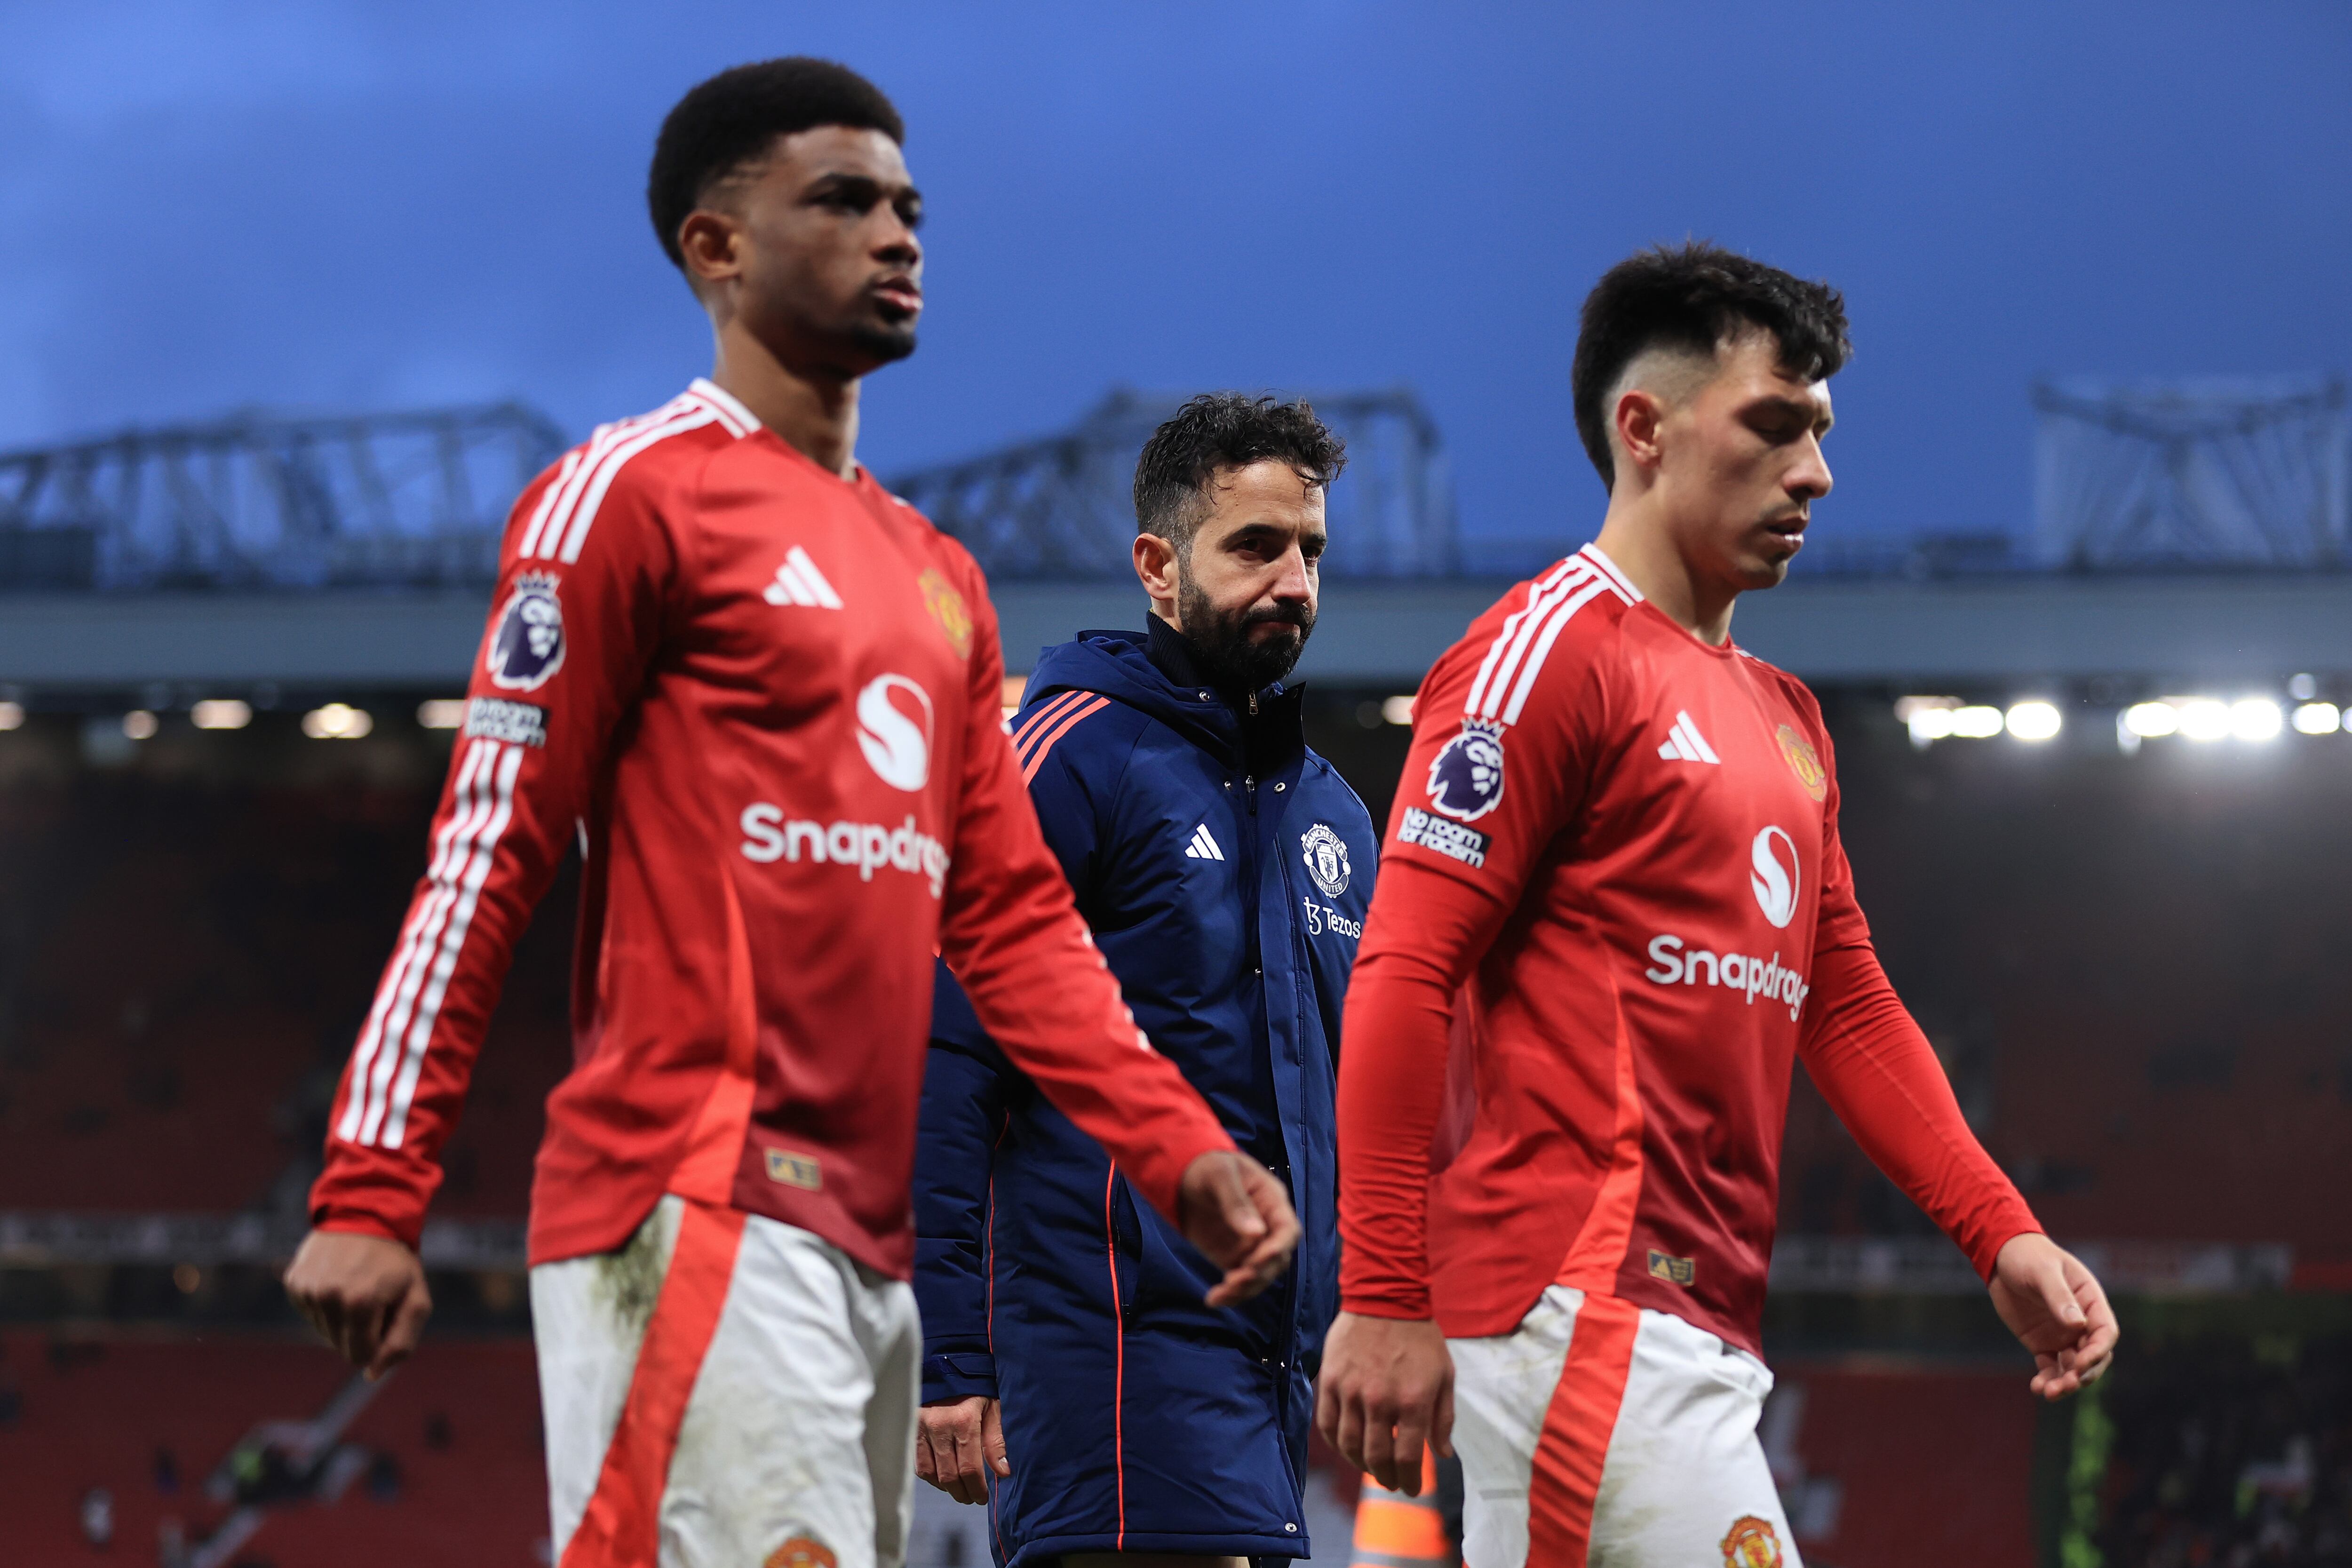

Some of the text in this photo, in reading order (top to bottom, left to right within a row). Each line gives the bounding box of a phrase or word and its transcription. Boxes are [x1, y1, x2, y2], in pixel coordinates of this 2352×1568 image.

[1305, 829, 1344, 857] MANCHESTER
[1427, 816, 1482, 851] room
[1318, 877, 1343, 893] UNITED
[1322, 907, 1361, 939] Tezos
